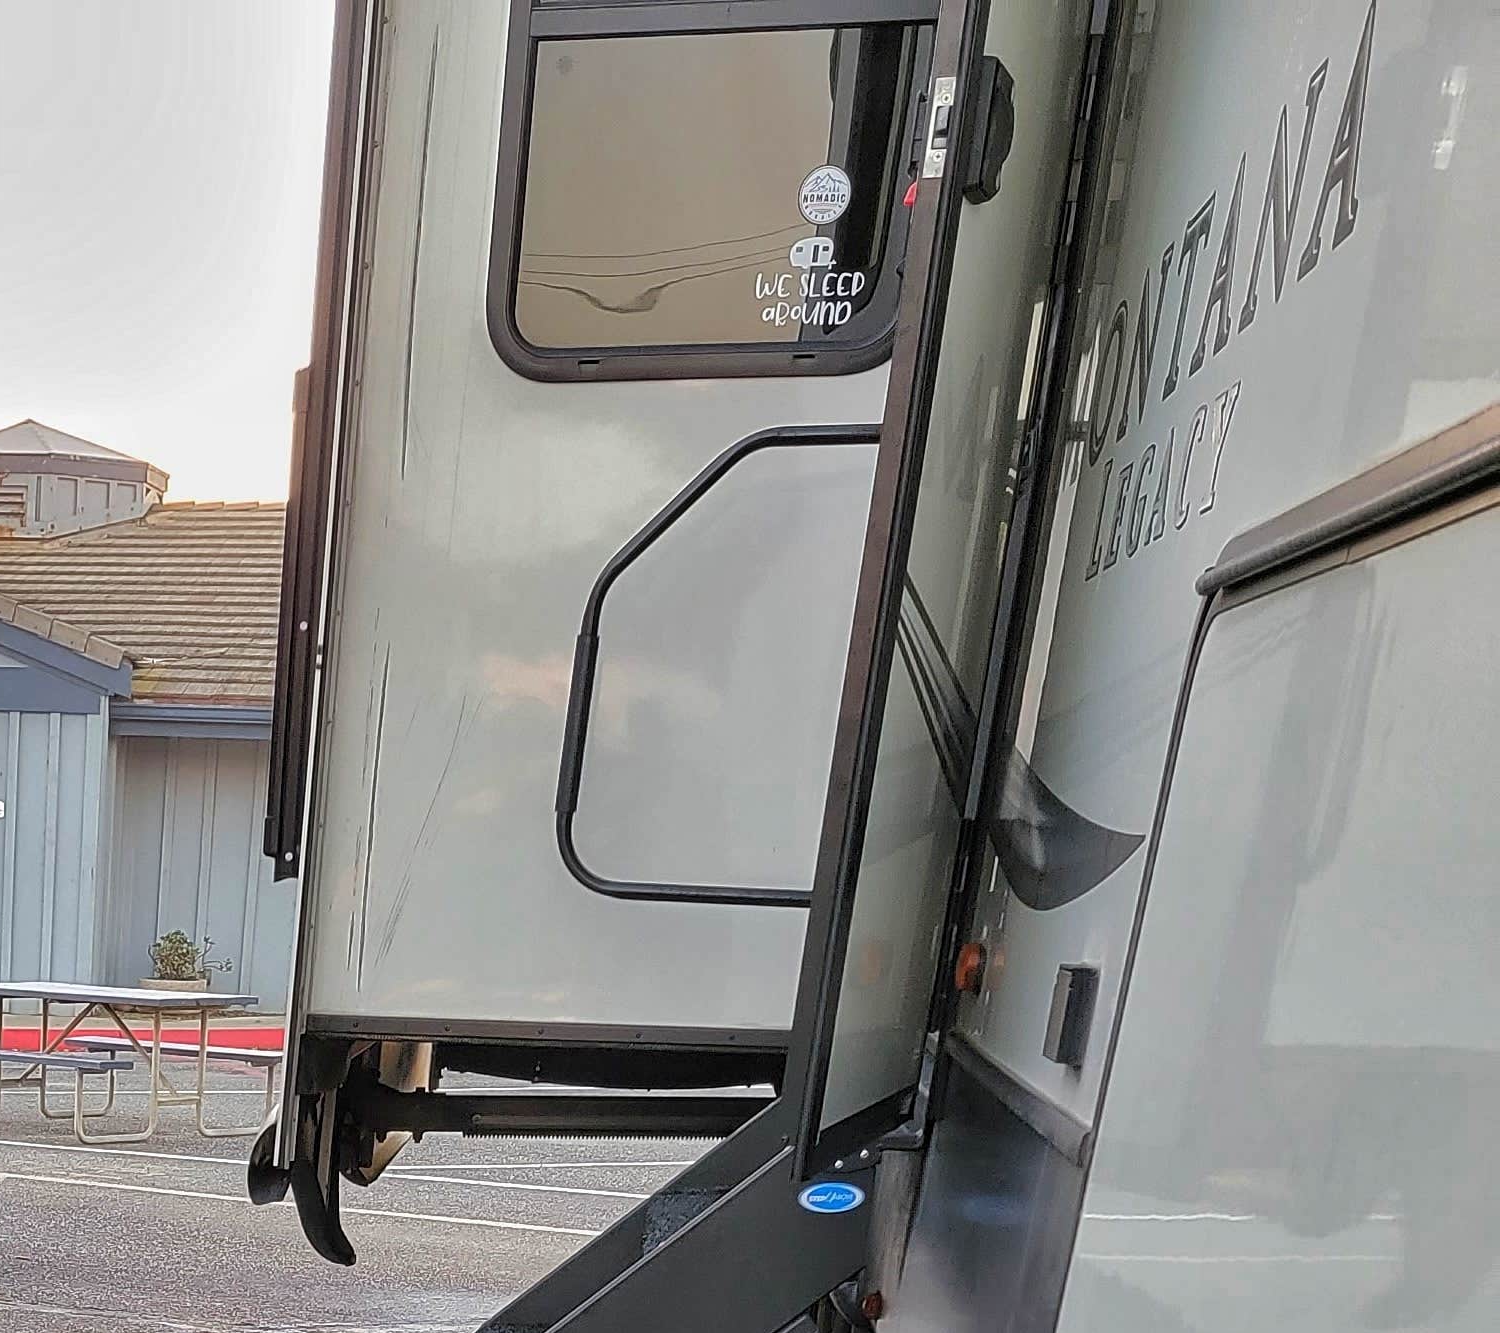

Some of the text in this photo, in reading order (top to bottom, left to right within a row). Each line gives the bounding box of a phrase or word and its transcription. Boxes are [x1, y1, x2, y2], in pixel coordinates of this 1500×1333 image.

[803, 193, 846, 203] NOMADIC
[755, 271, 865, 299] WE SLEEP
[1085, 379, 1241, 582] LEGACY
